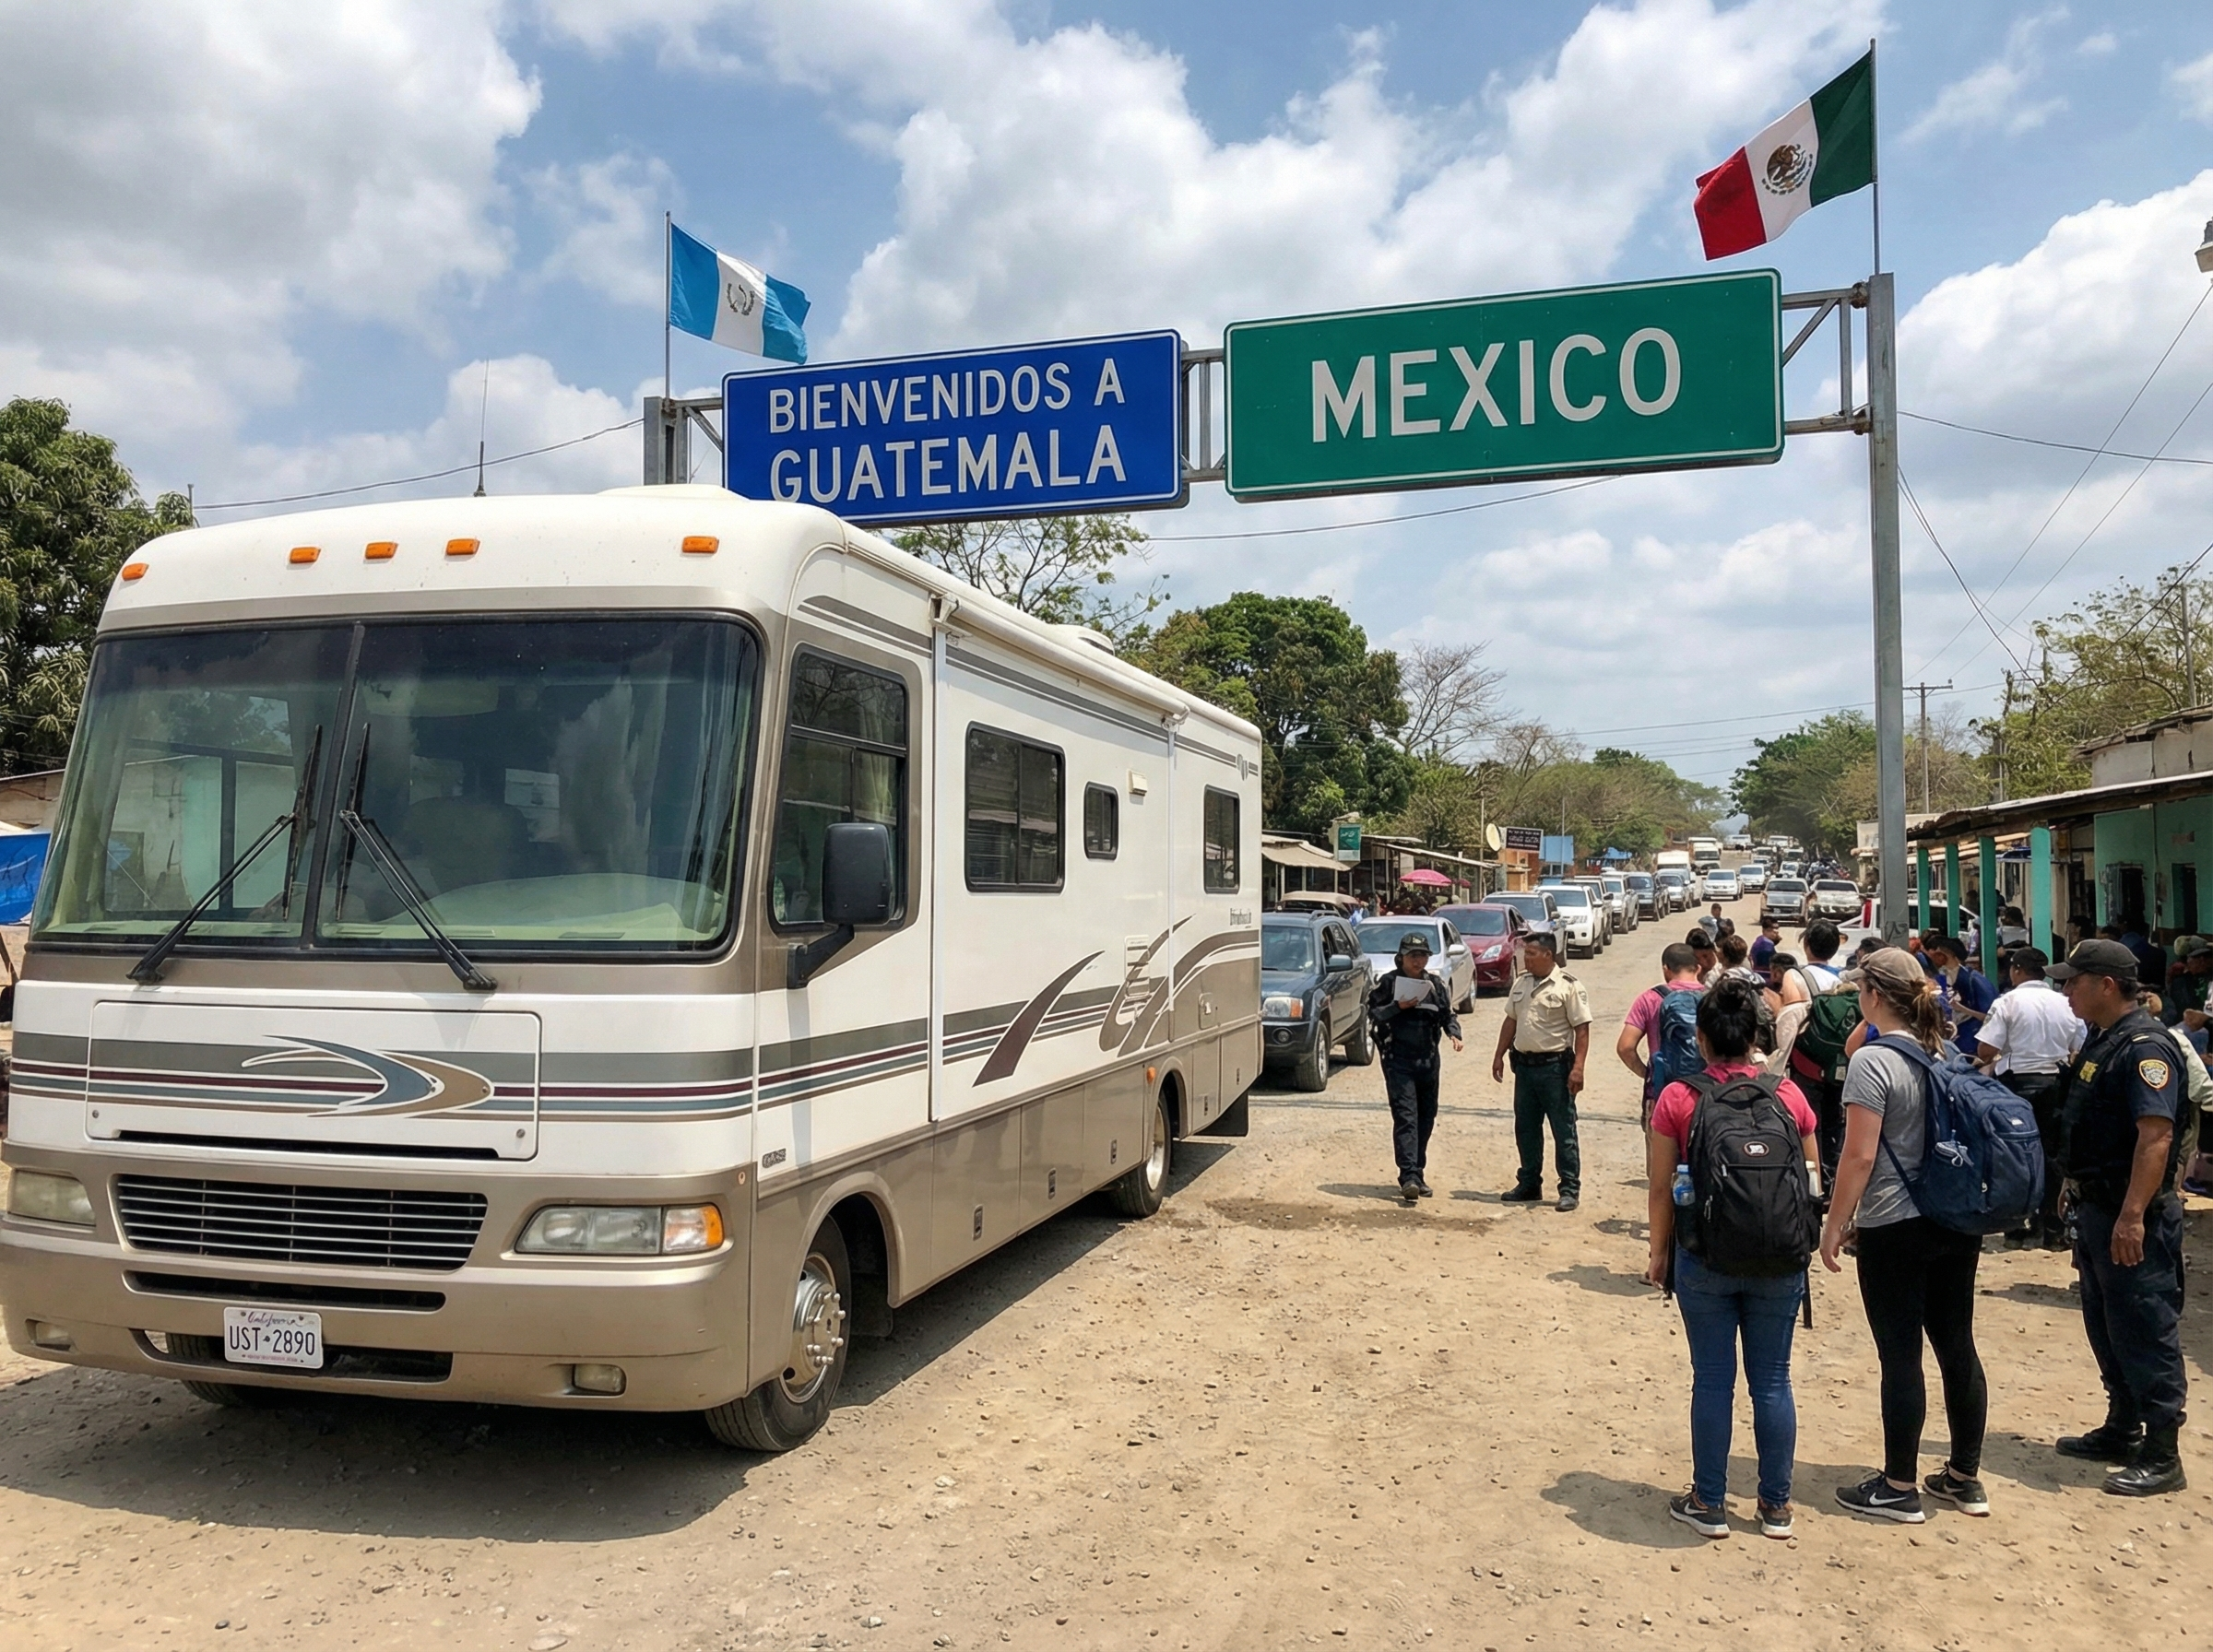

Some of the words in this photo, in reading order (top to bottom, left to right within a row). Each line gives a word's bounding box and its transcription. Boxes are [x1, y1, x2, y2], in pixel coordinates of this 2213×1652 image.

[770, 362, 1071, 433] BIENVENIDOS
[1095, 358, 1125, 406] A
[1311, 327, 1682, 442] MEXICO
[770, 424, 1127, 503] GUATEMALA
